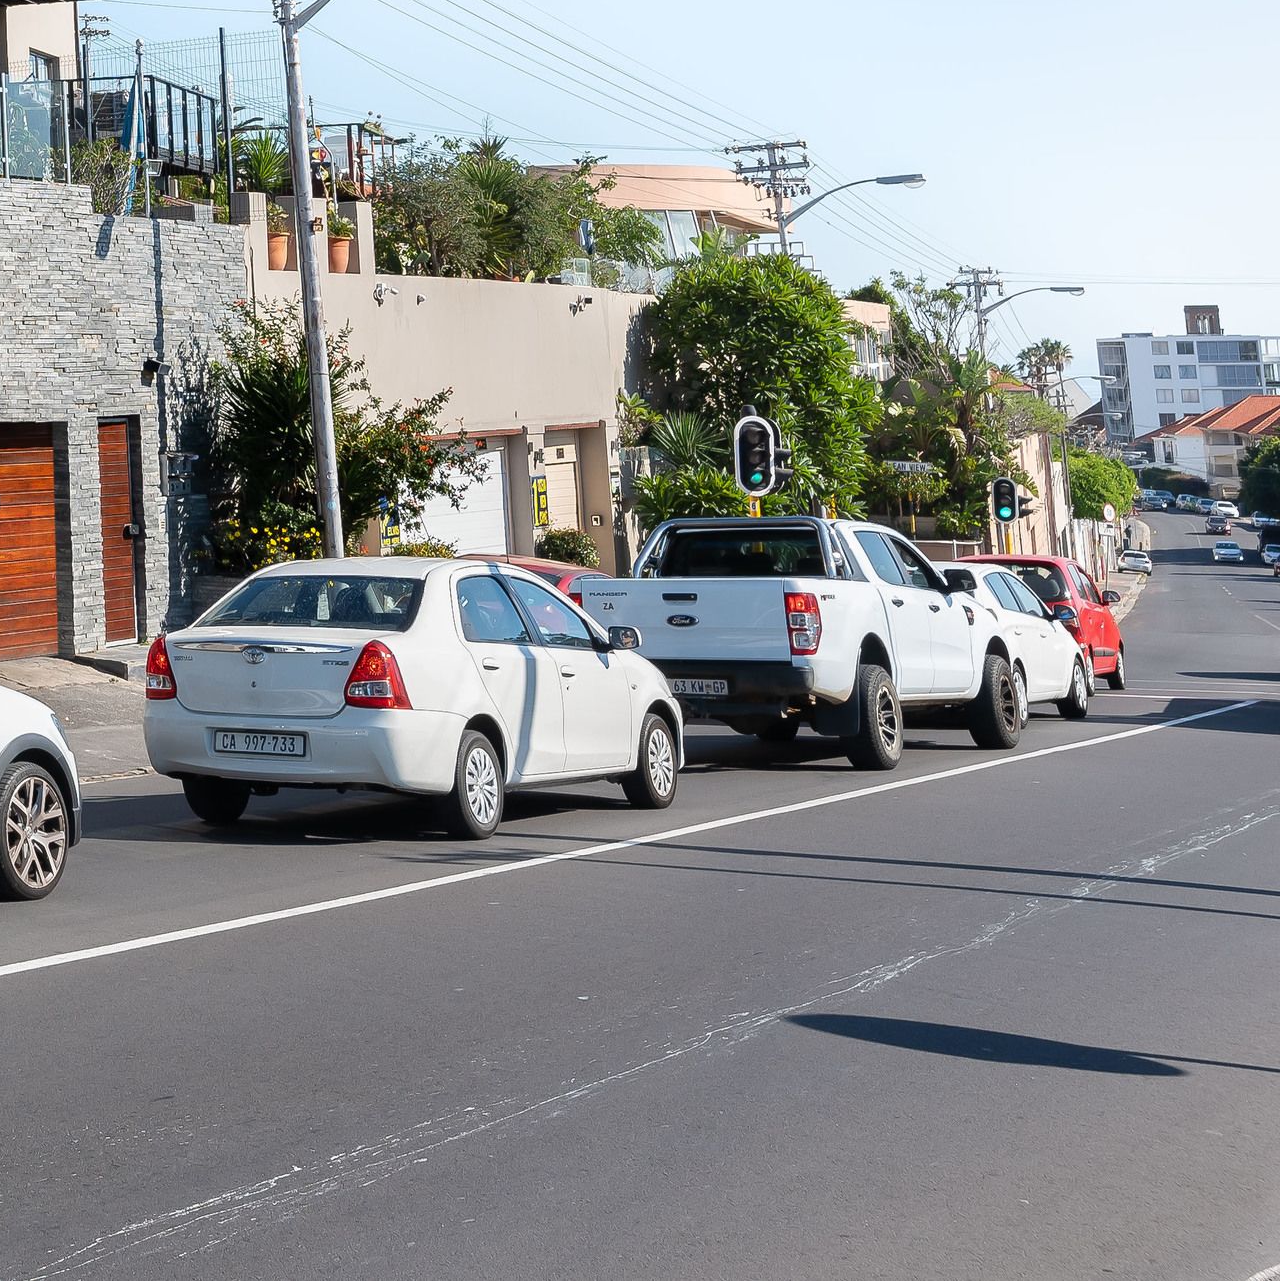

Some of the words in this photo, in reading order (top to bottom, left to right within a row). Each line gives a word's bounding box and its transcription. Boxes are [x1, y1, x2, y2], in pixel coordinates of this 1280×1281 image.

[603, 602, 614, 610] ZA
[674, 680, 686, 692] 63
[713, 681, 725, 694] GP
[222, 734, 236, 749] CA
[244, 735, 295, 752] 997-733
